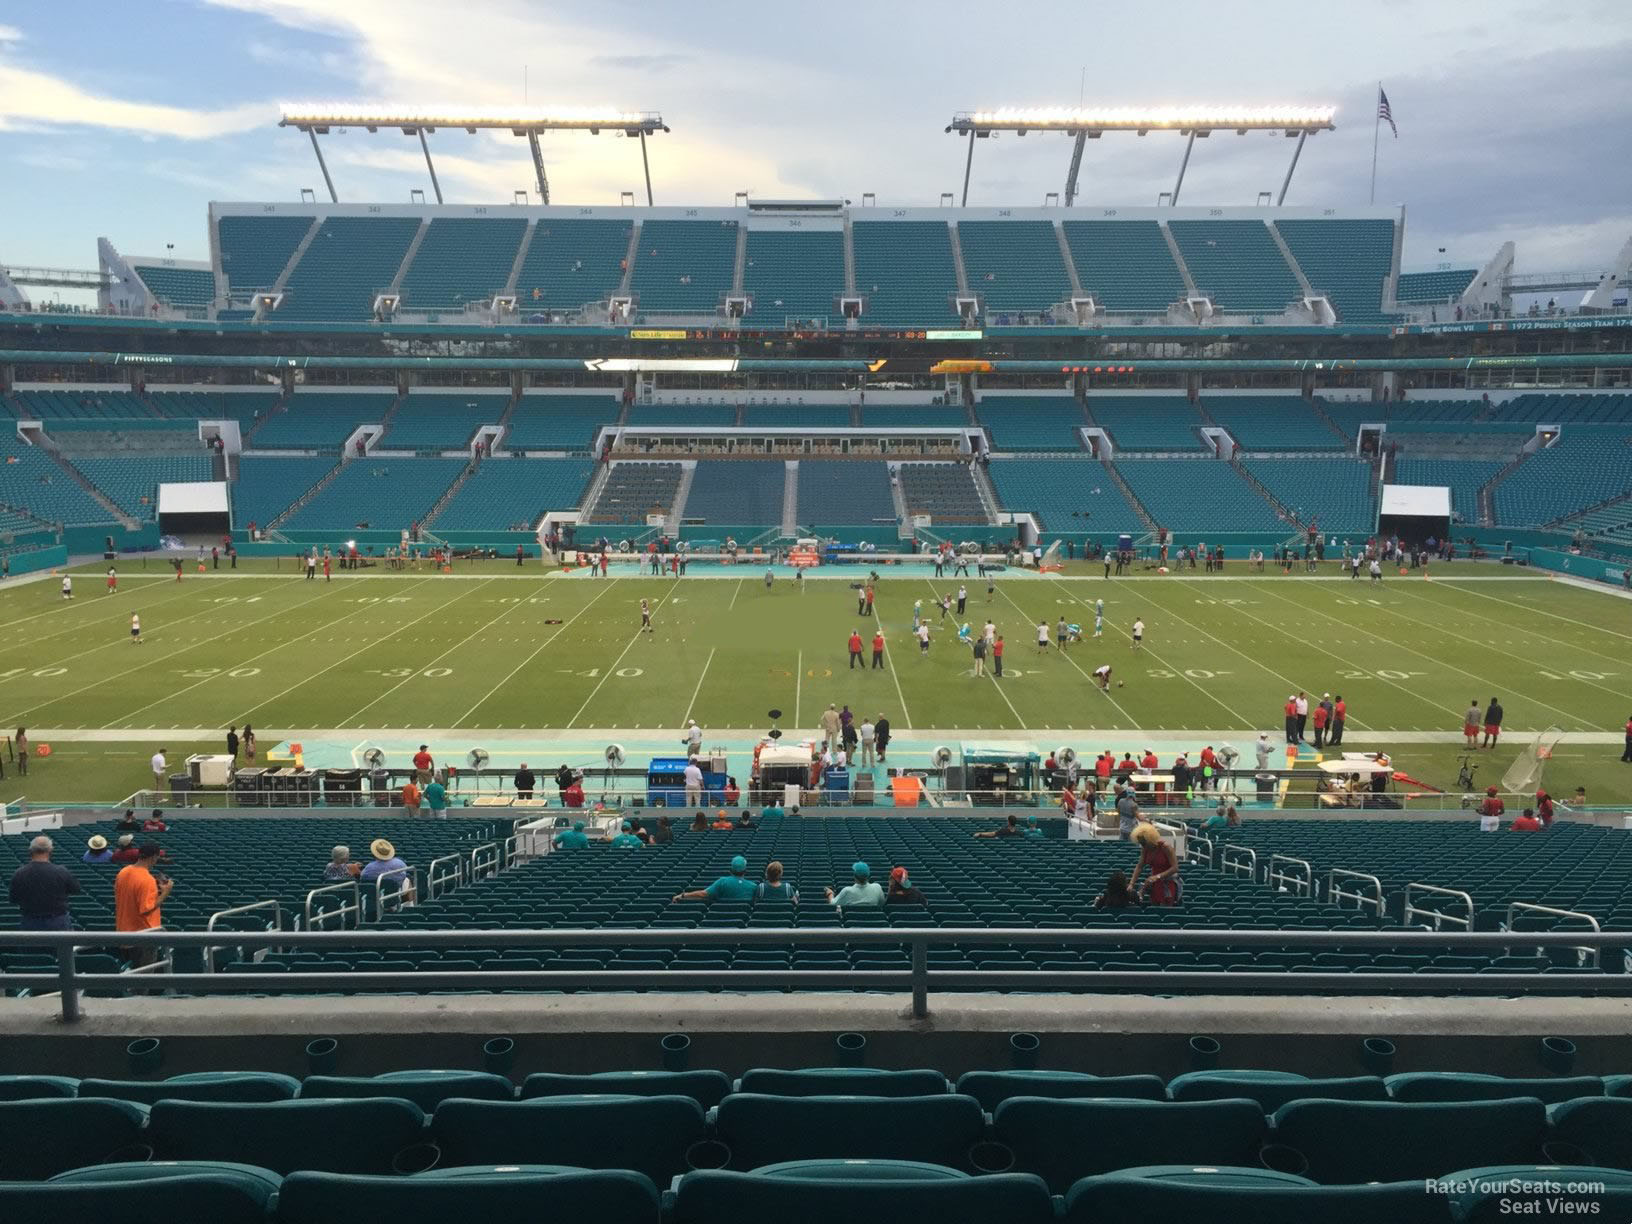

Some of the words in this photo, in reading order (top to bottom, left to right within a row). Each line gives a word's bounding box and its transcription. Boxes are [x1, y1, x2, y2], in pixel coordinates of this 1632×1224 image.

[1512, 322, 1532, 330] 1972
[183, 668, 261, 677] 20
[381, 667, 453, 677] 30
[576, 667, 643, 677] 40
[1146, 669, 1215, 678] 30
[1336, 670, 1410, 679] 20
